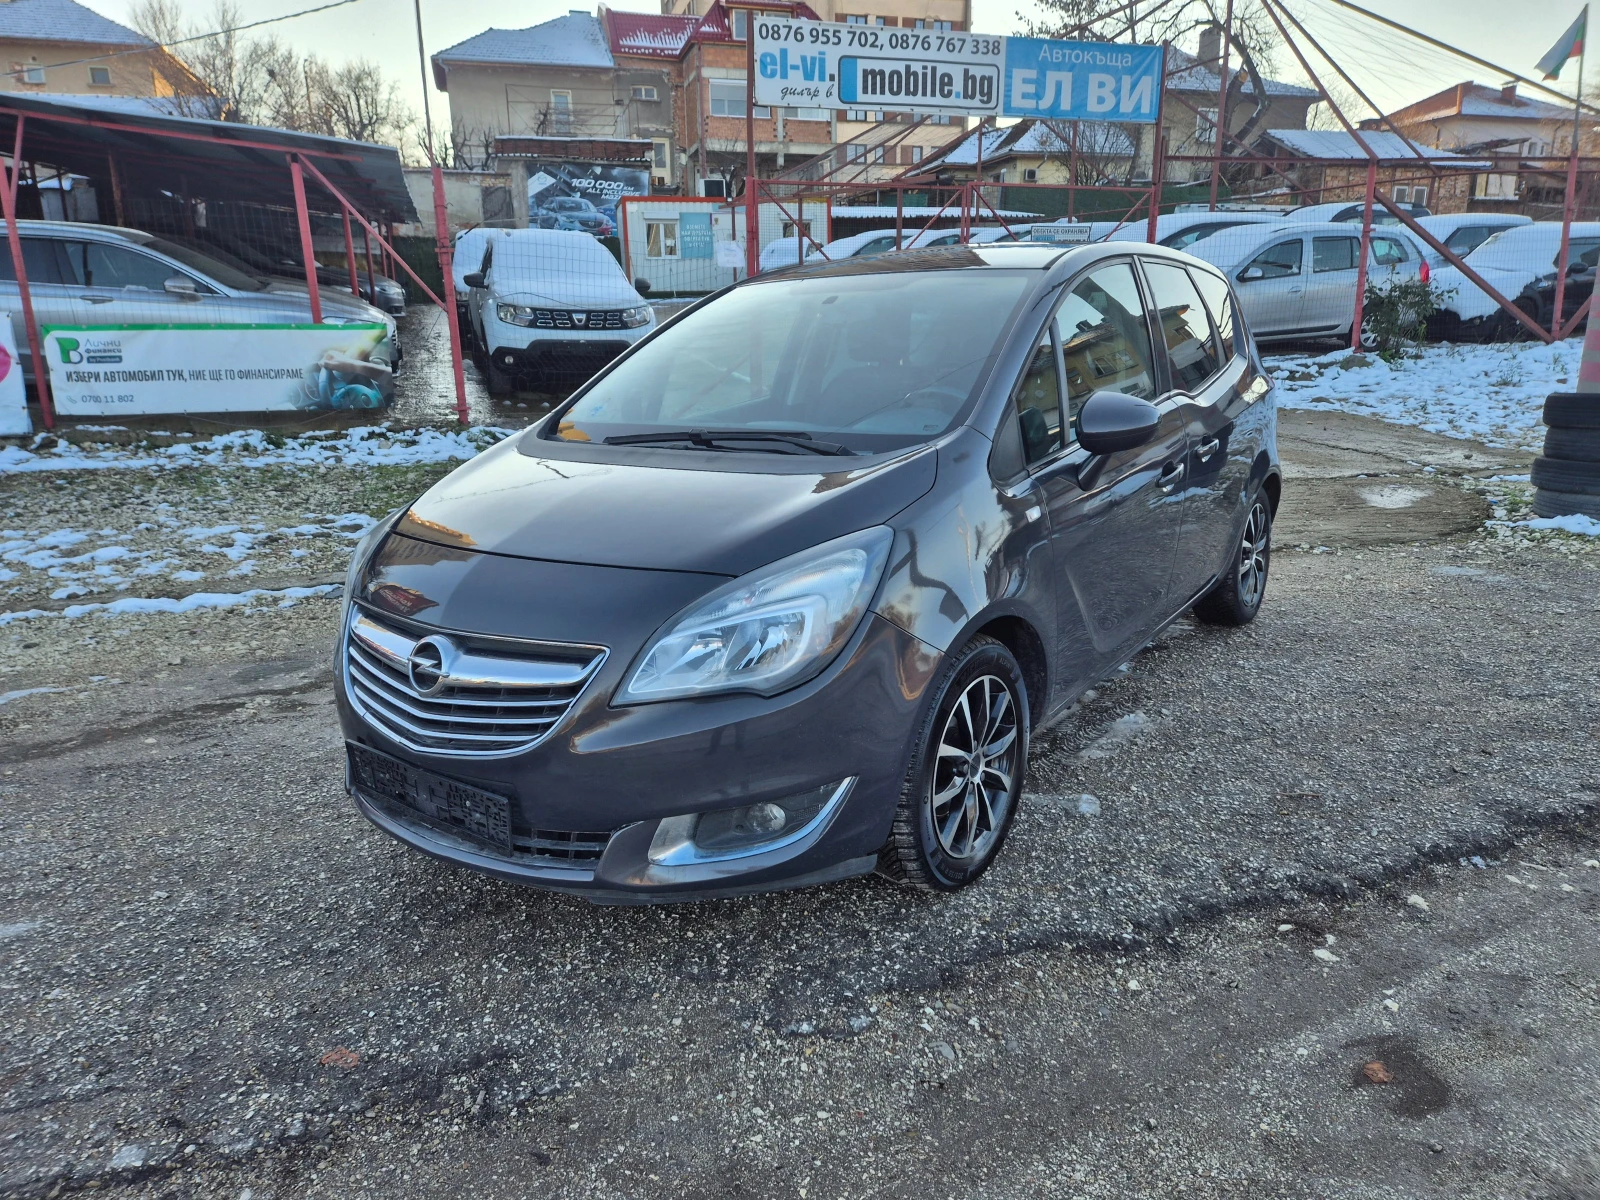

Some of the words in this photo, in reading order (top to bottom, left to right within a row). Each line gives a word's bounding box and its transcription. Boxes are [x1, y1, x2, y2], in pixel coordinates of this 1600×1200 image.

[758, 23, 805, 43] 0876
[809, 27, 842, 46] 955
[847, 30, 884, 51] 702,
[888, 33, 932, 51] 0876
[936, 36, 967, 53] 767
[970, 39, 1002, 56] 338
[1038, 43, 1132, 69] Автокъща
[862, 64, 994, 105] mobile.bg
[1010, 67, 1073, 111] ЕЛ
[1086, 72, 1153, 114] ВИ
[571, 178, 595, 188] 100
[595, 180, 624, 190] 000
[103, 369, 164, 382] АВТОМОБИЛ
[165, 369, 187, 382] ТУК,
[188, 369, 207, 381] НИЕ
[208, 369, 224, 382] ЩЕ
[224, 369, 236, 380] ГО
[237, 367, 304, 380] ФИНАНСИРАМЕ
[104, 395, 115, 403] 11
[117, 394, 134, 403] 802
